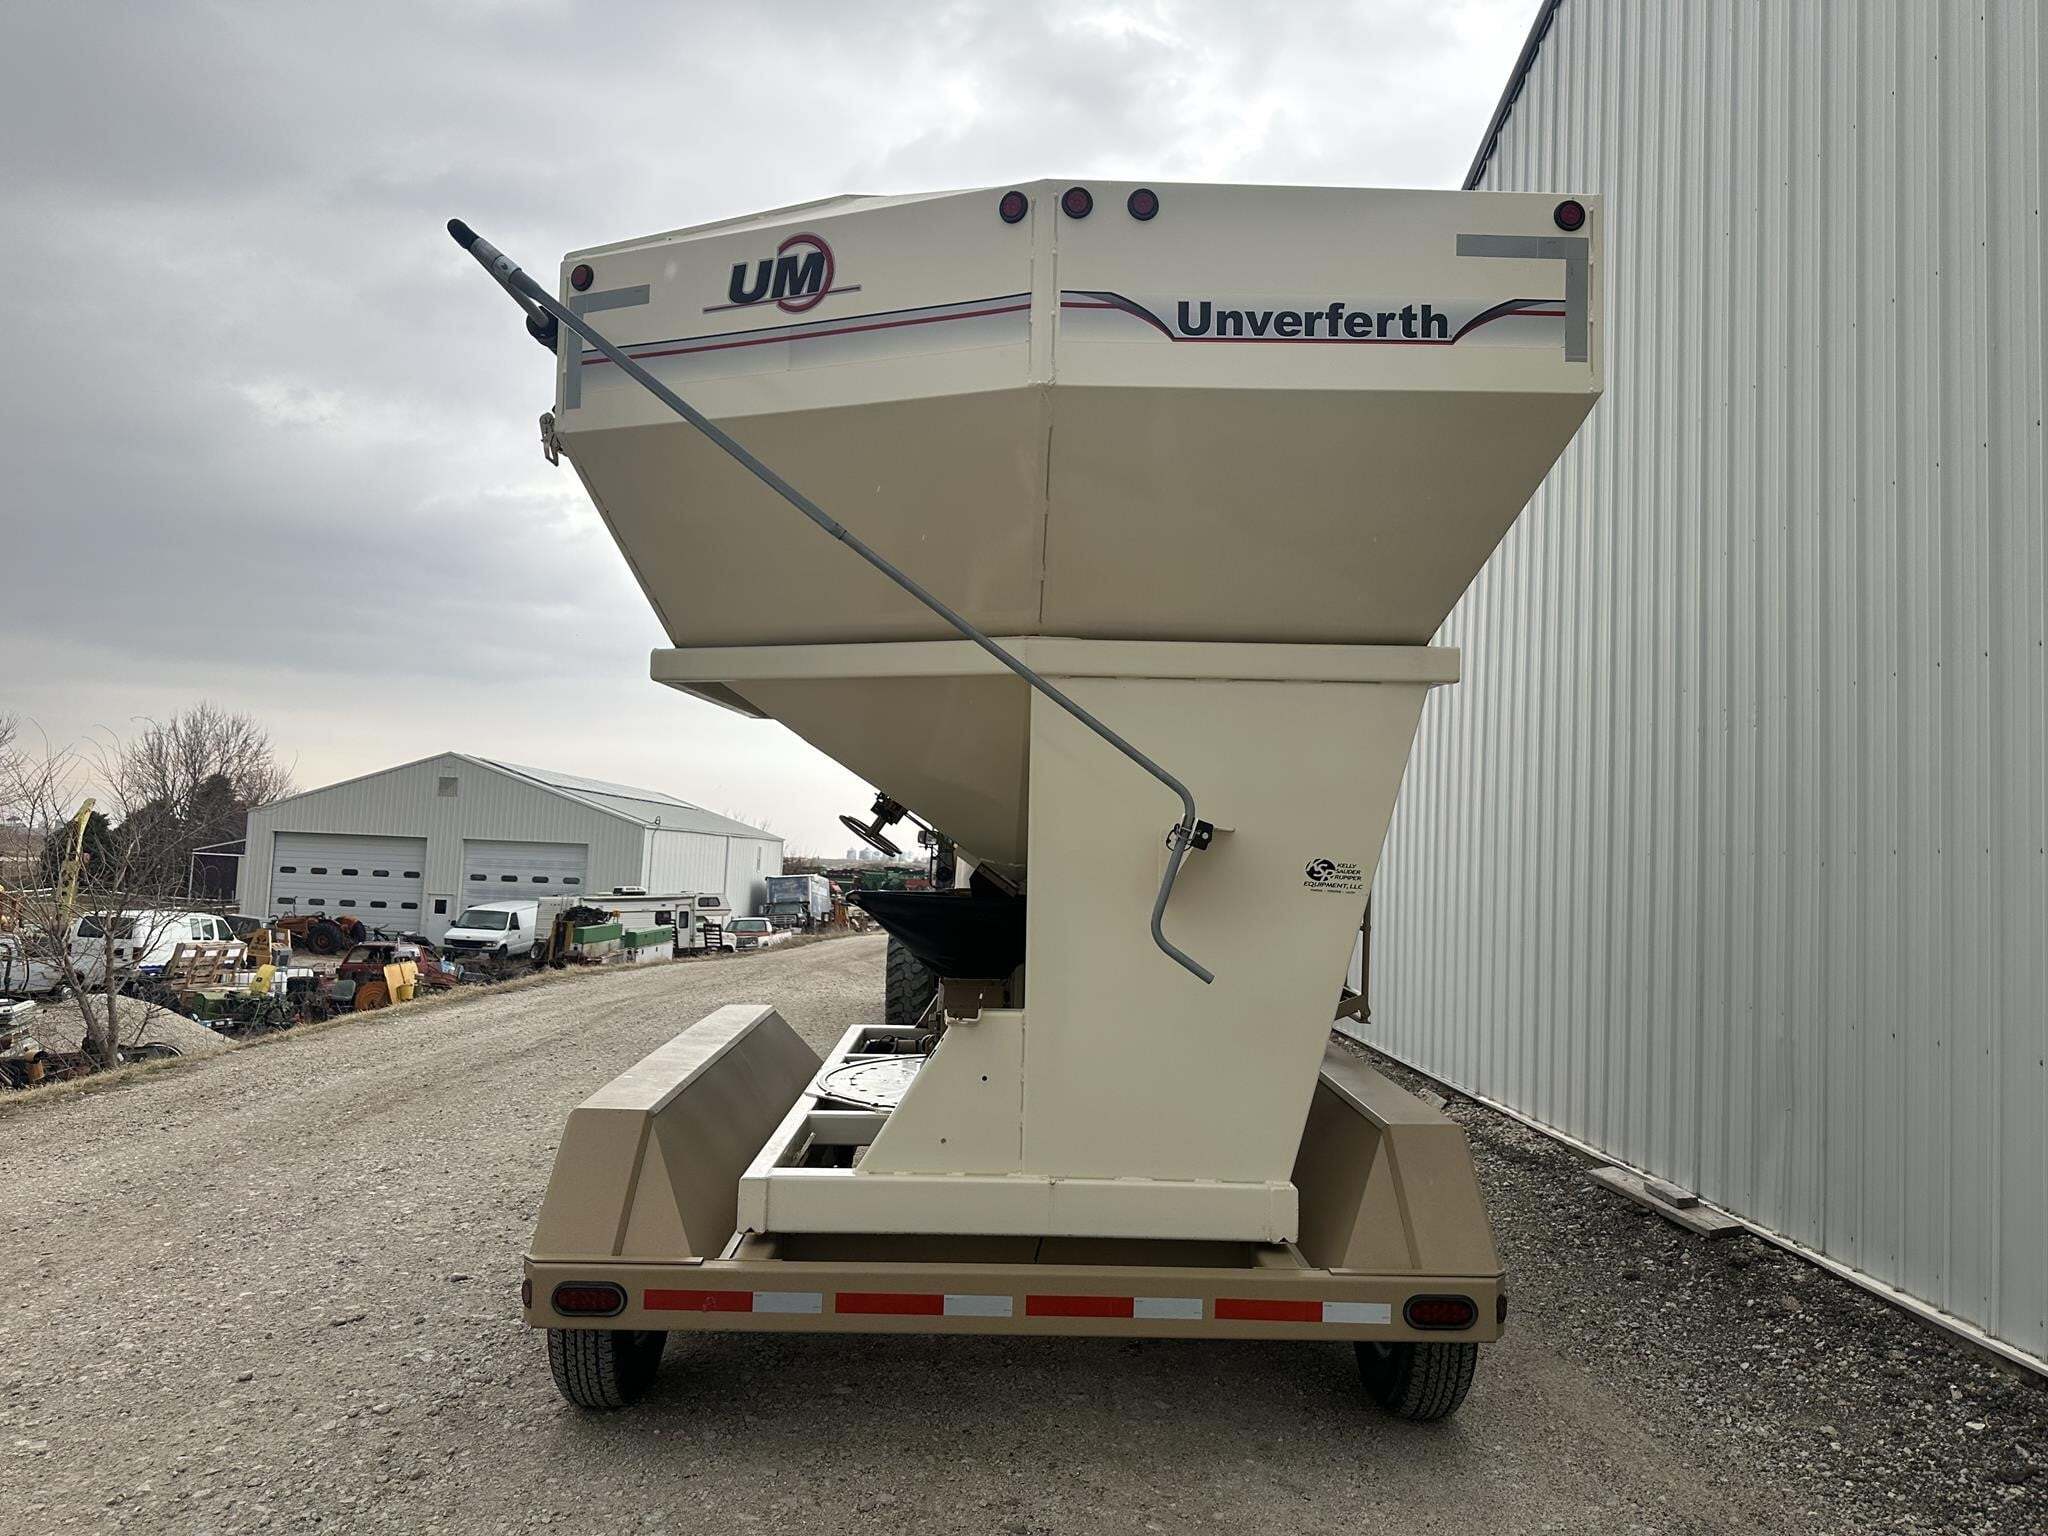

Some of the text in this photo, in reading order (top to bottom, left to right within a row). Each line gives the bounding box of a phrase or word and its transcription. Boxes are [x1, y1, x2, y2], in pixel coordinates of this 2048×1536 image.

[729, 251, 826, 304] UM
[1177, 300, 1449, 338] Unverferth
[1303, 881, 1349, 890] EQUIPMENT,
